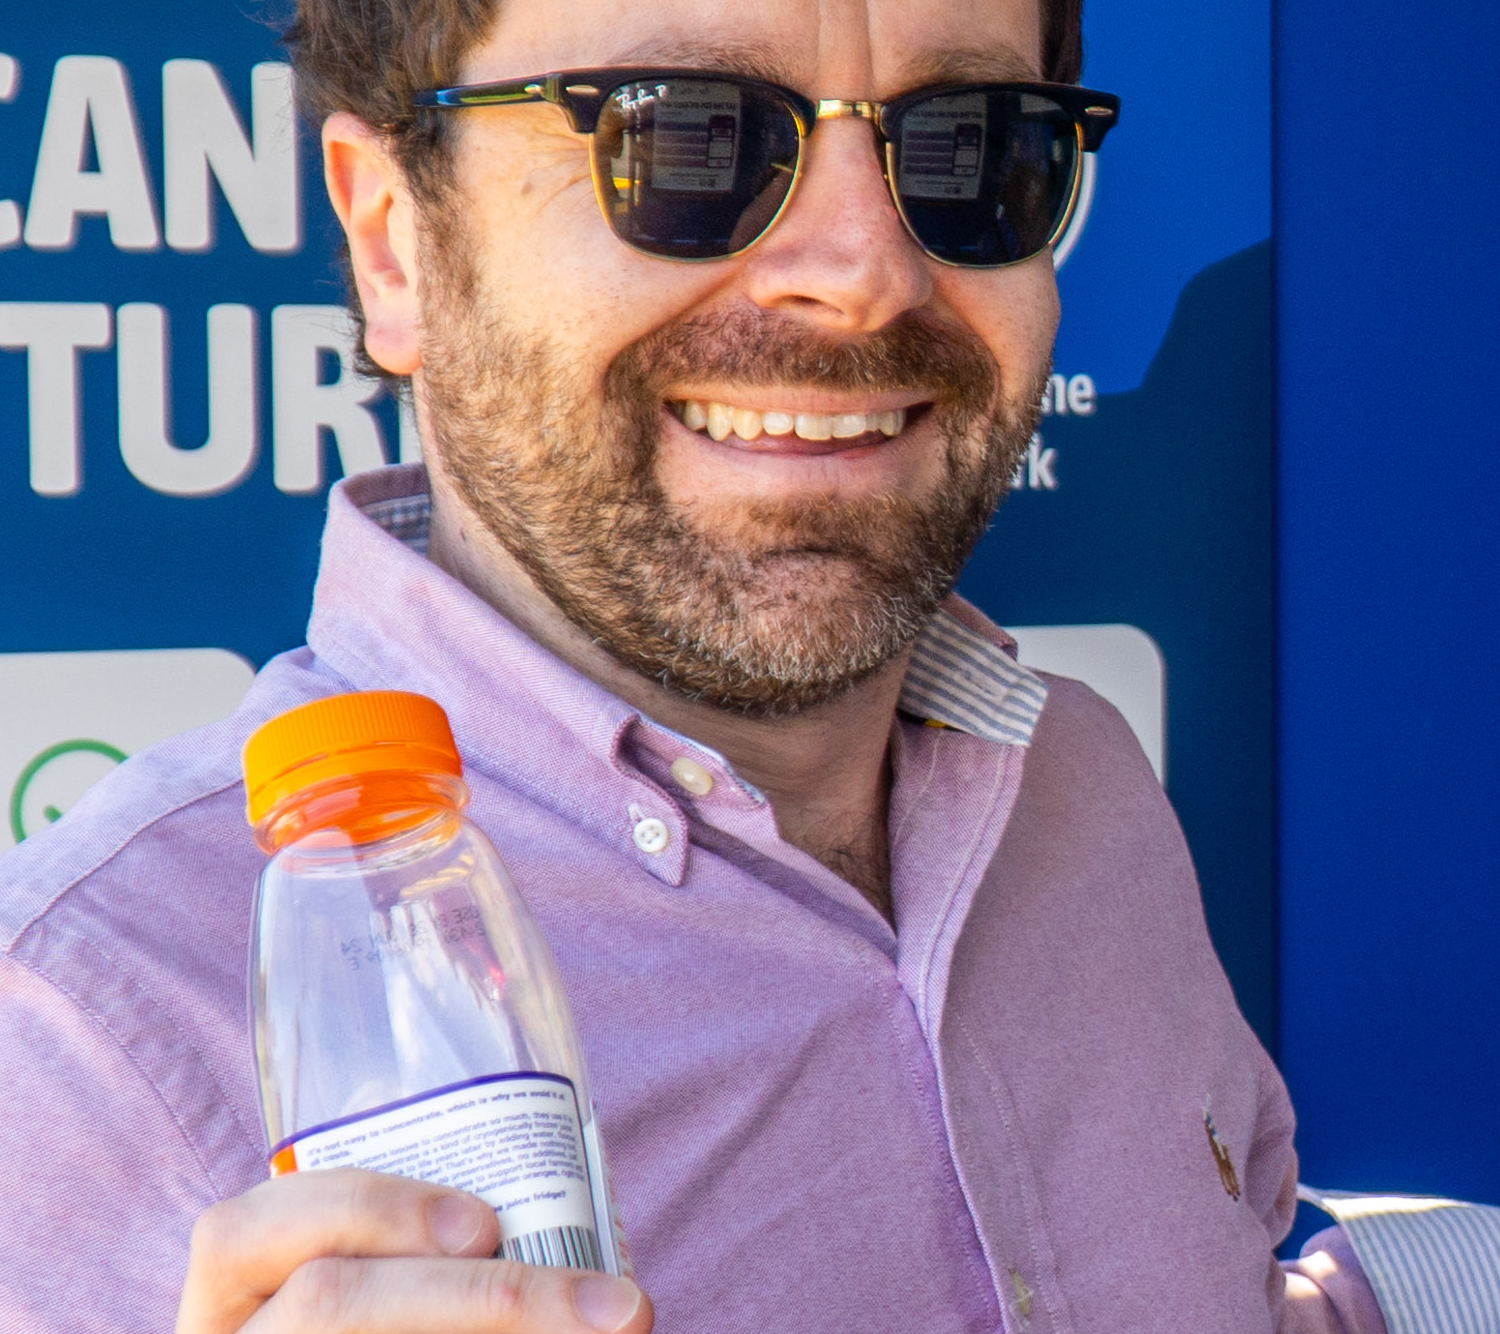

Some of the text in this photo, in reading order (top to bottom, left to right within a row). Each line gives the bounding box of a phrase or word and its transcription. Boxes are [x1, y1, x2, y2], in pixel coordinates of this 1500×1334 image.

[344, 1135, 366, 1145] easy
[447, 1100, 475, 1113] which
[490, 1092, 510, 1102] why
[506, 1190, 566, 1210] juice fridge?
